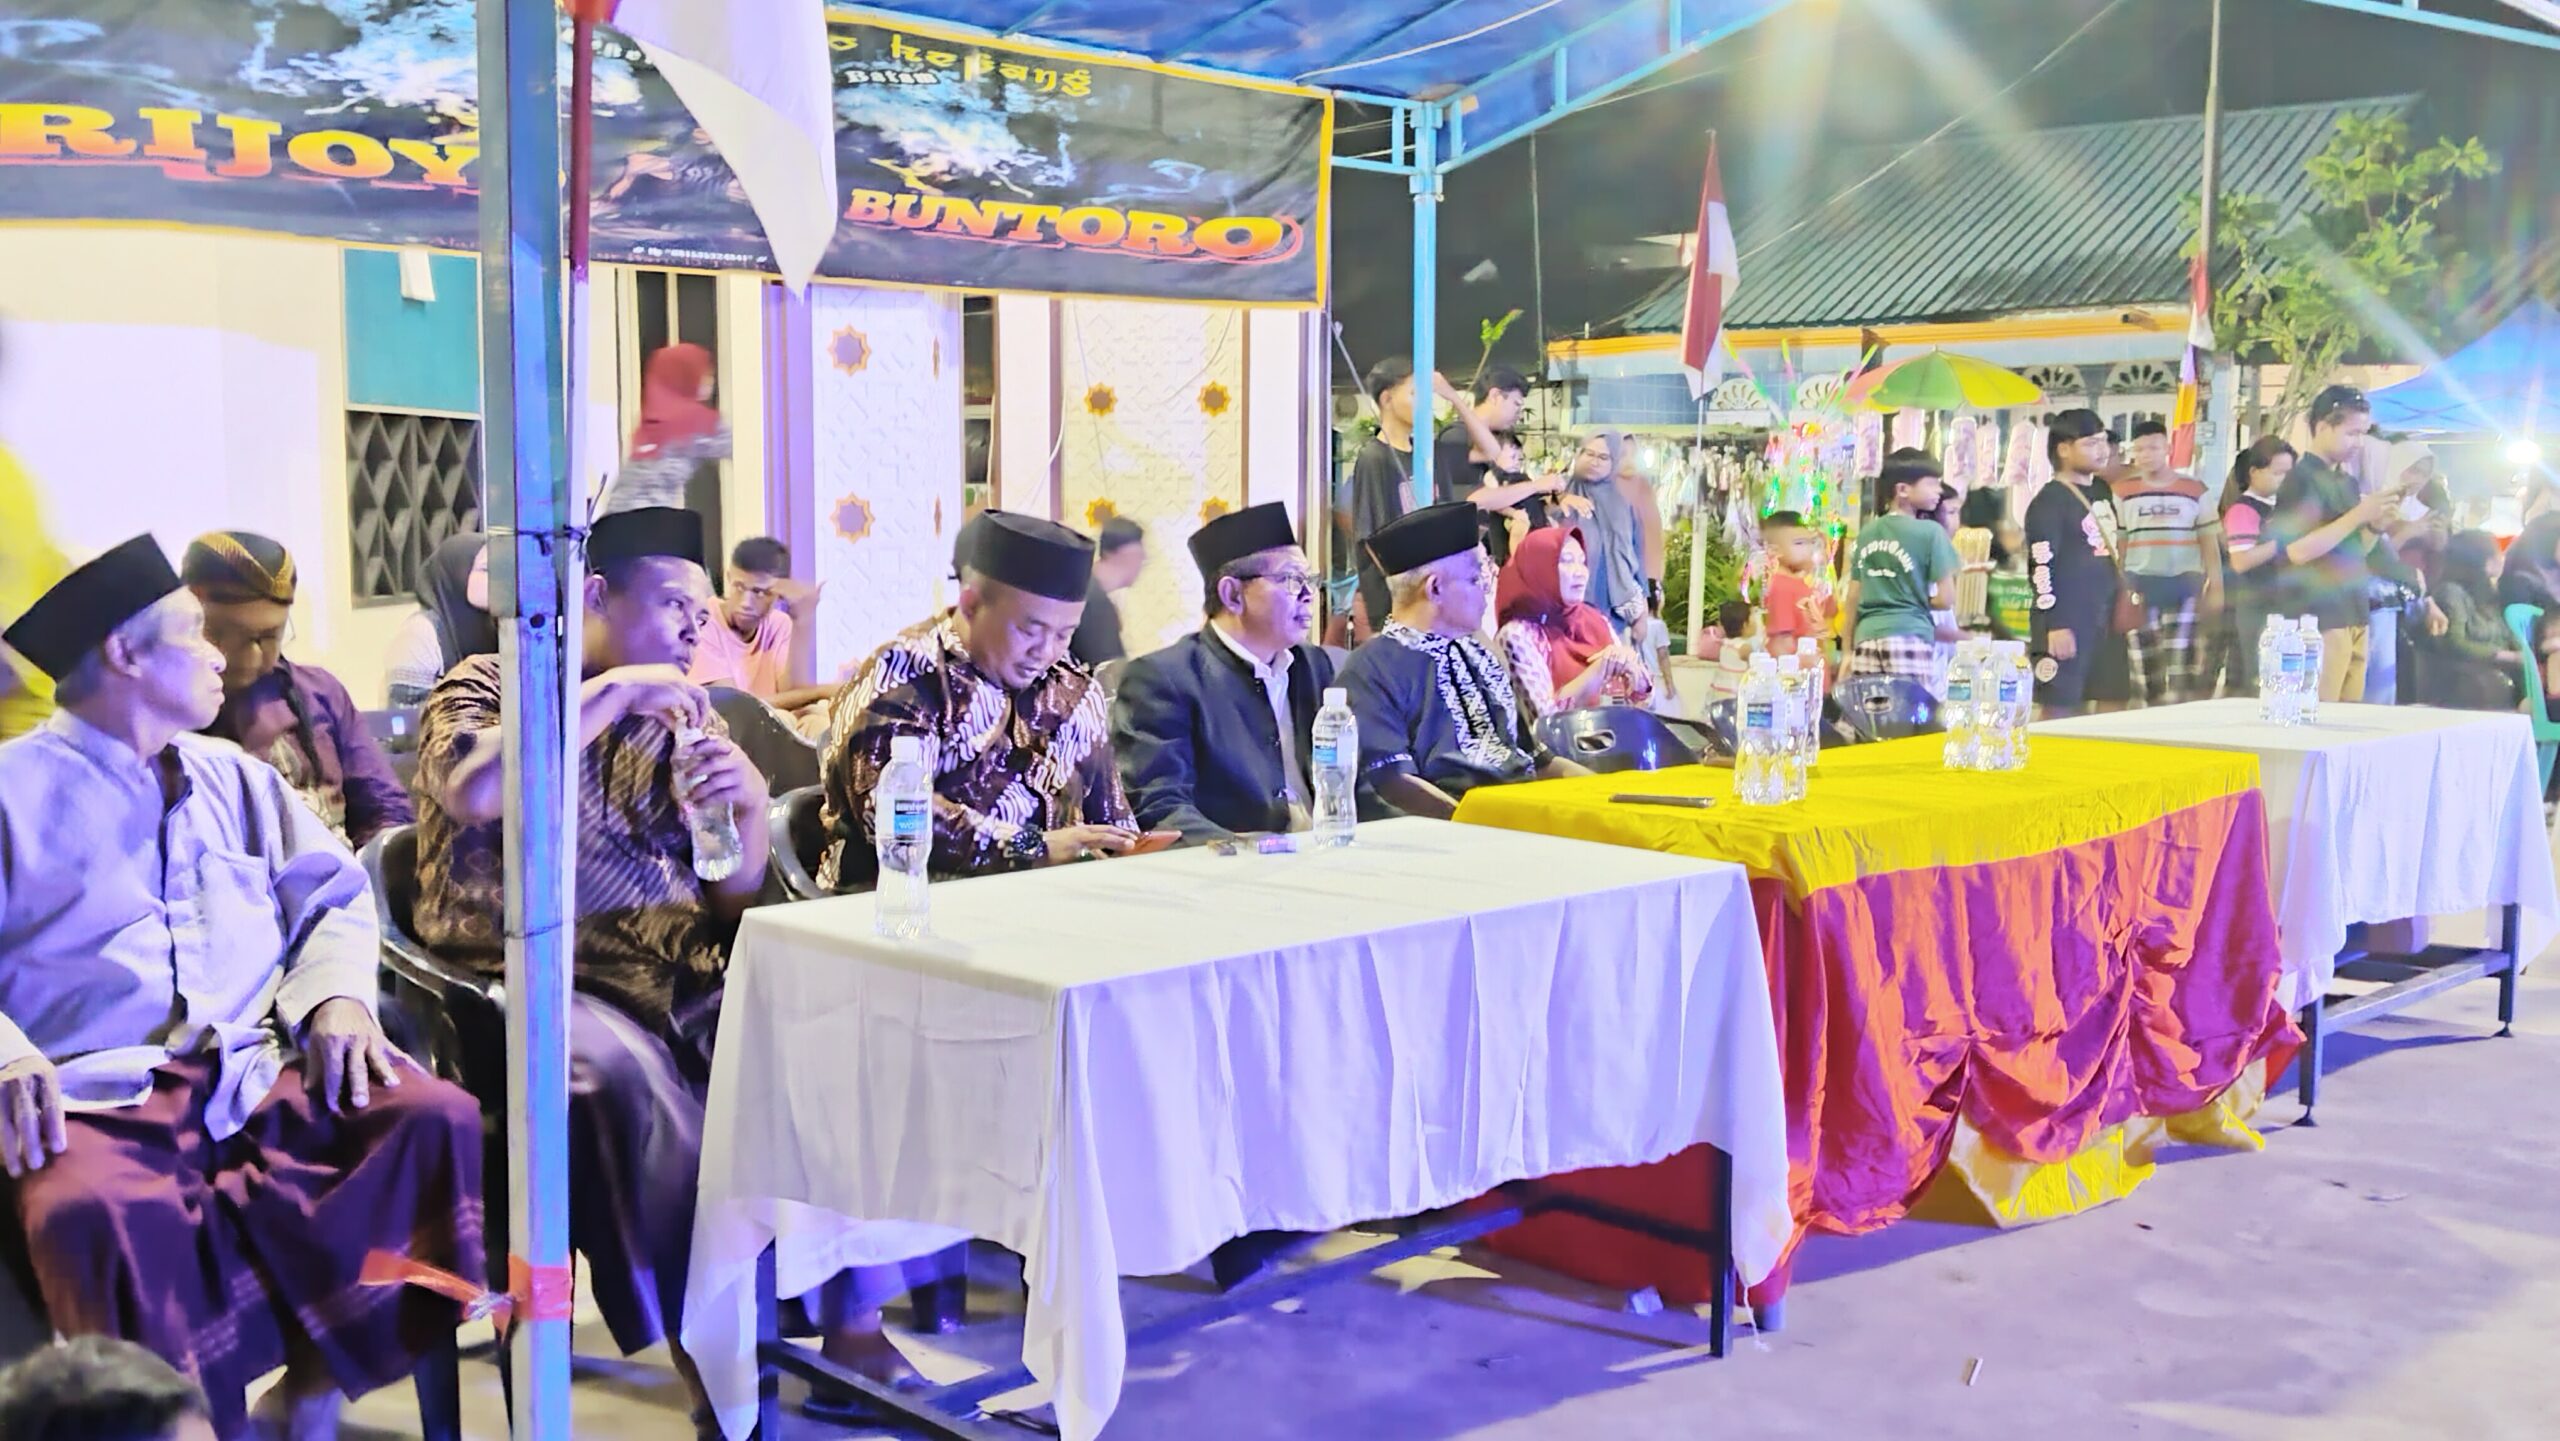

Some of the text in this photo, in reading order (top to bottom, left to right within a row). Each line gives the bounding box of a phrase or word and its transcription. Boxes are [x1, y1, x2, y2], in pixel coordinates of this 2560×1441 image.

[845, 69, 939, 85] Batam
[0, 103, 1284, 257] RIJOY BUNTORO
